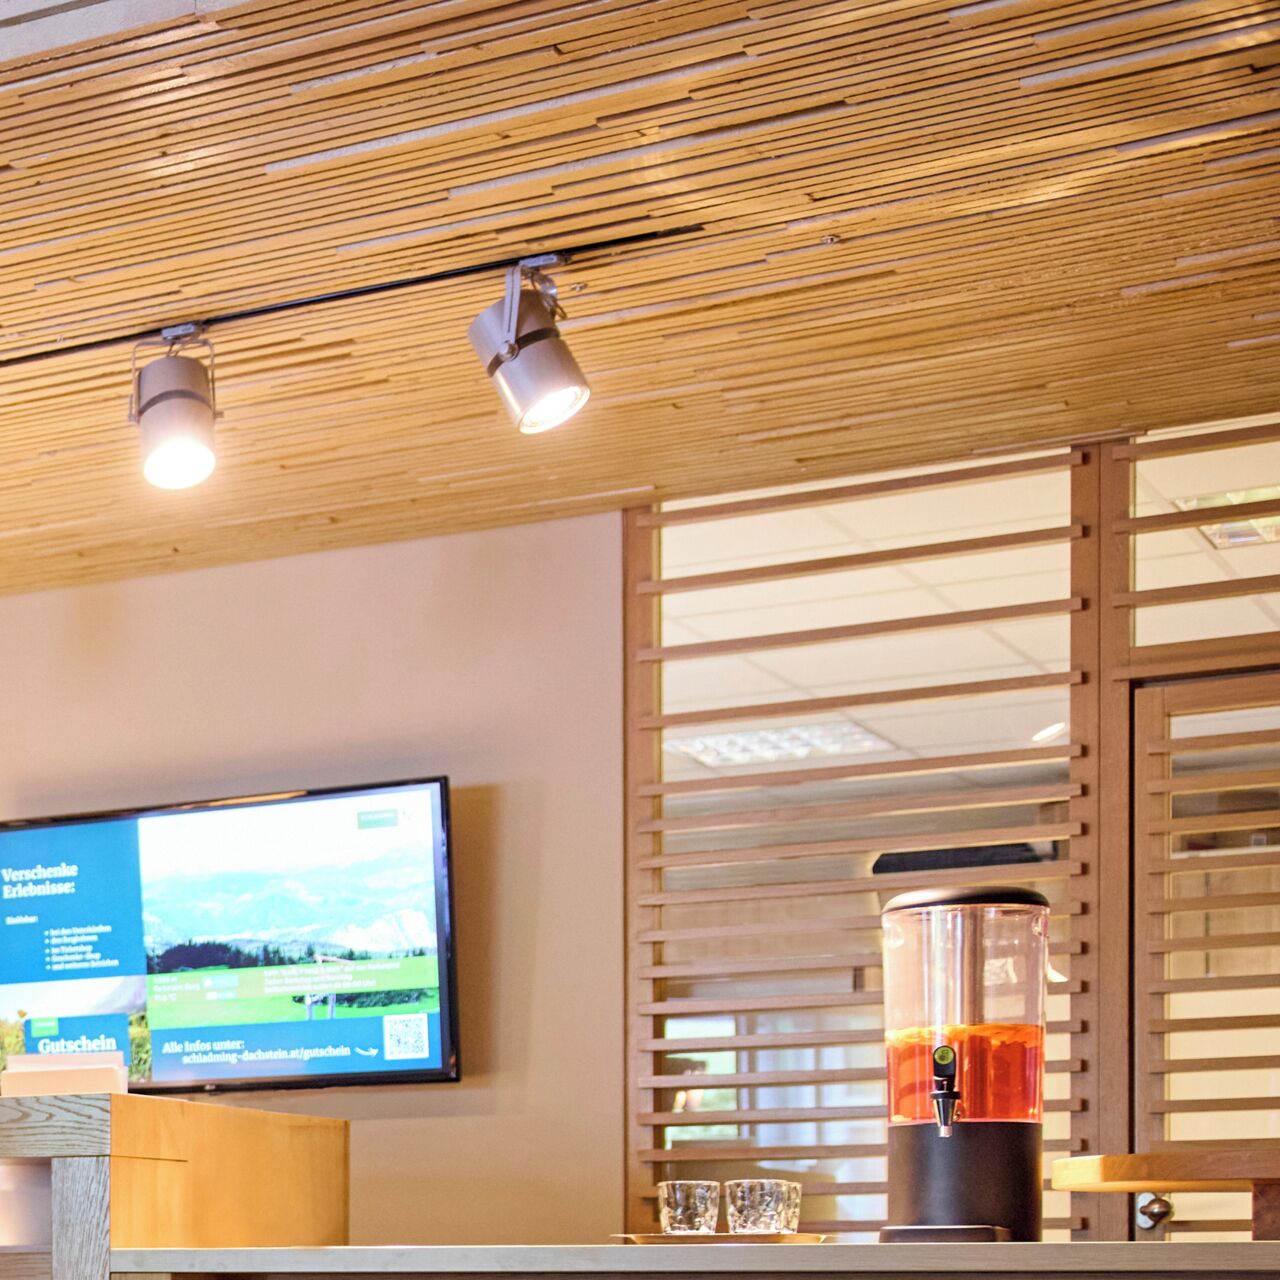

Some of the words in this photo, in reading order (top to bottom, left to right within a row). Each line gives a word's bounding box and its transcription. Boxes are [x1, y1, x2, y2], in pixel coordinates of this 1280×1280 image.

[1, 863, 78, 882] Verschenke
[3, 882, 76, 899] Erlebnisse:
[37, 1034, 117, 1054] Gutschein
[161, 1041, 183, 1054] Alle
[183, 1040, 211, 1053] Infos
[212, 1039, 244, 1052] unter:
[182, 1044, 351, 1065] schladming-dachstein.at/gutschein
